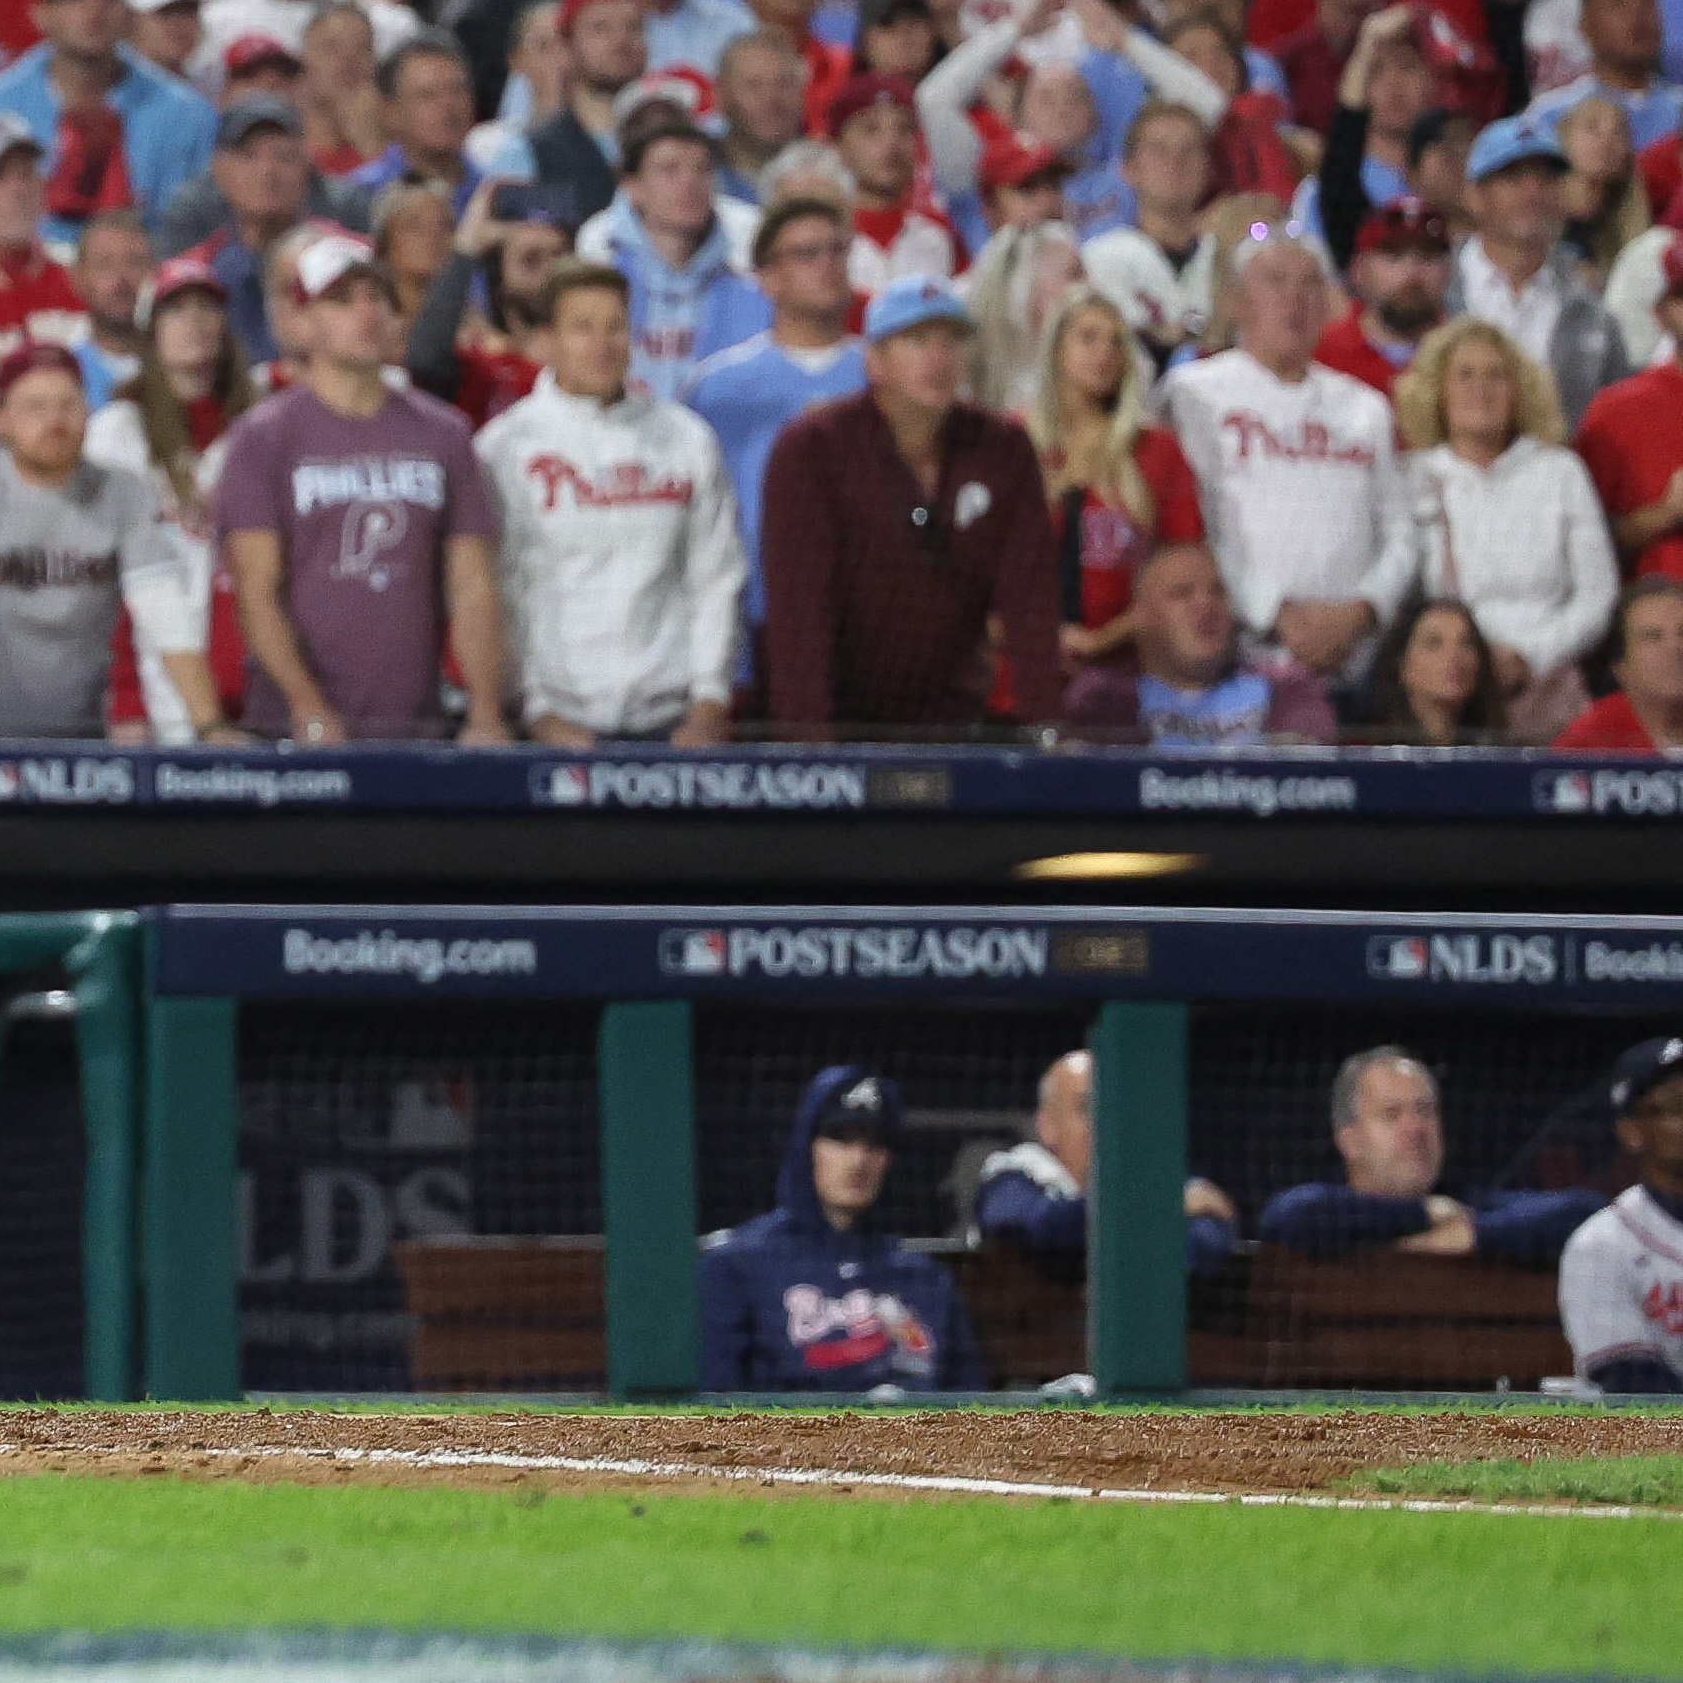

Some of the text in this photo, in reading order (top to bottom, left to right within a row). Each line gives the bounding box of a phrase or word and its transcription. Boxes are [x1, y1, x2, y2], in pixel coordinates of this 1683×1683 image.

[589, 761, 867, 809] POSTSEASON
[283, 928, 538, 984] Booking.com
[728, 927, 1049, 978] POSTSEASON
[1431, 933, 1557, 985] NLDS
